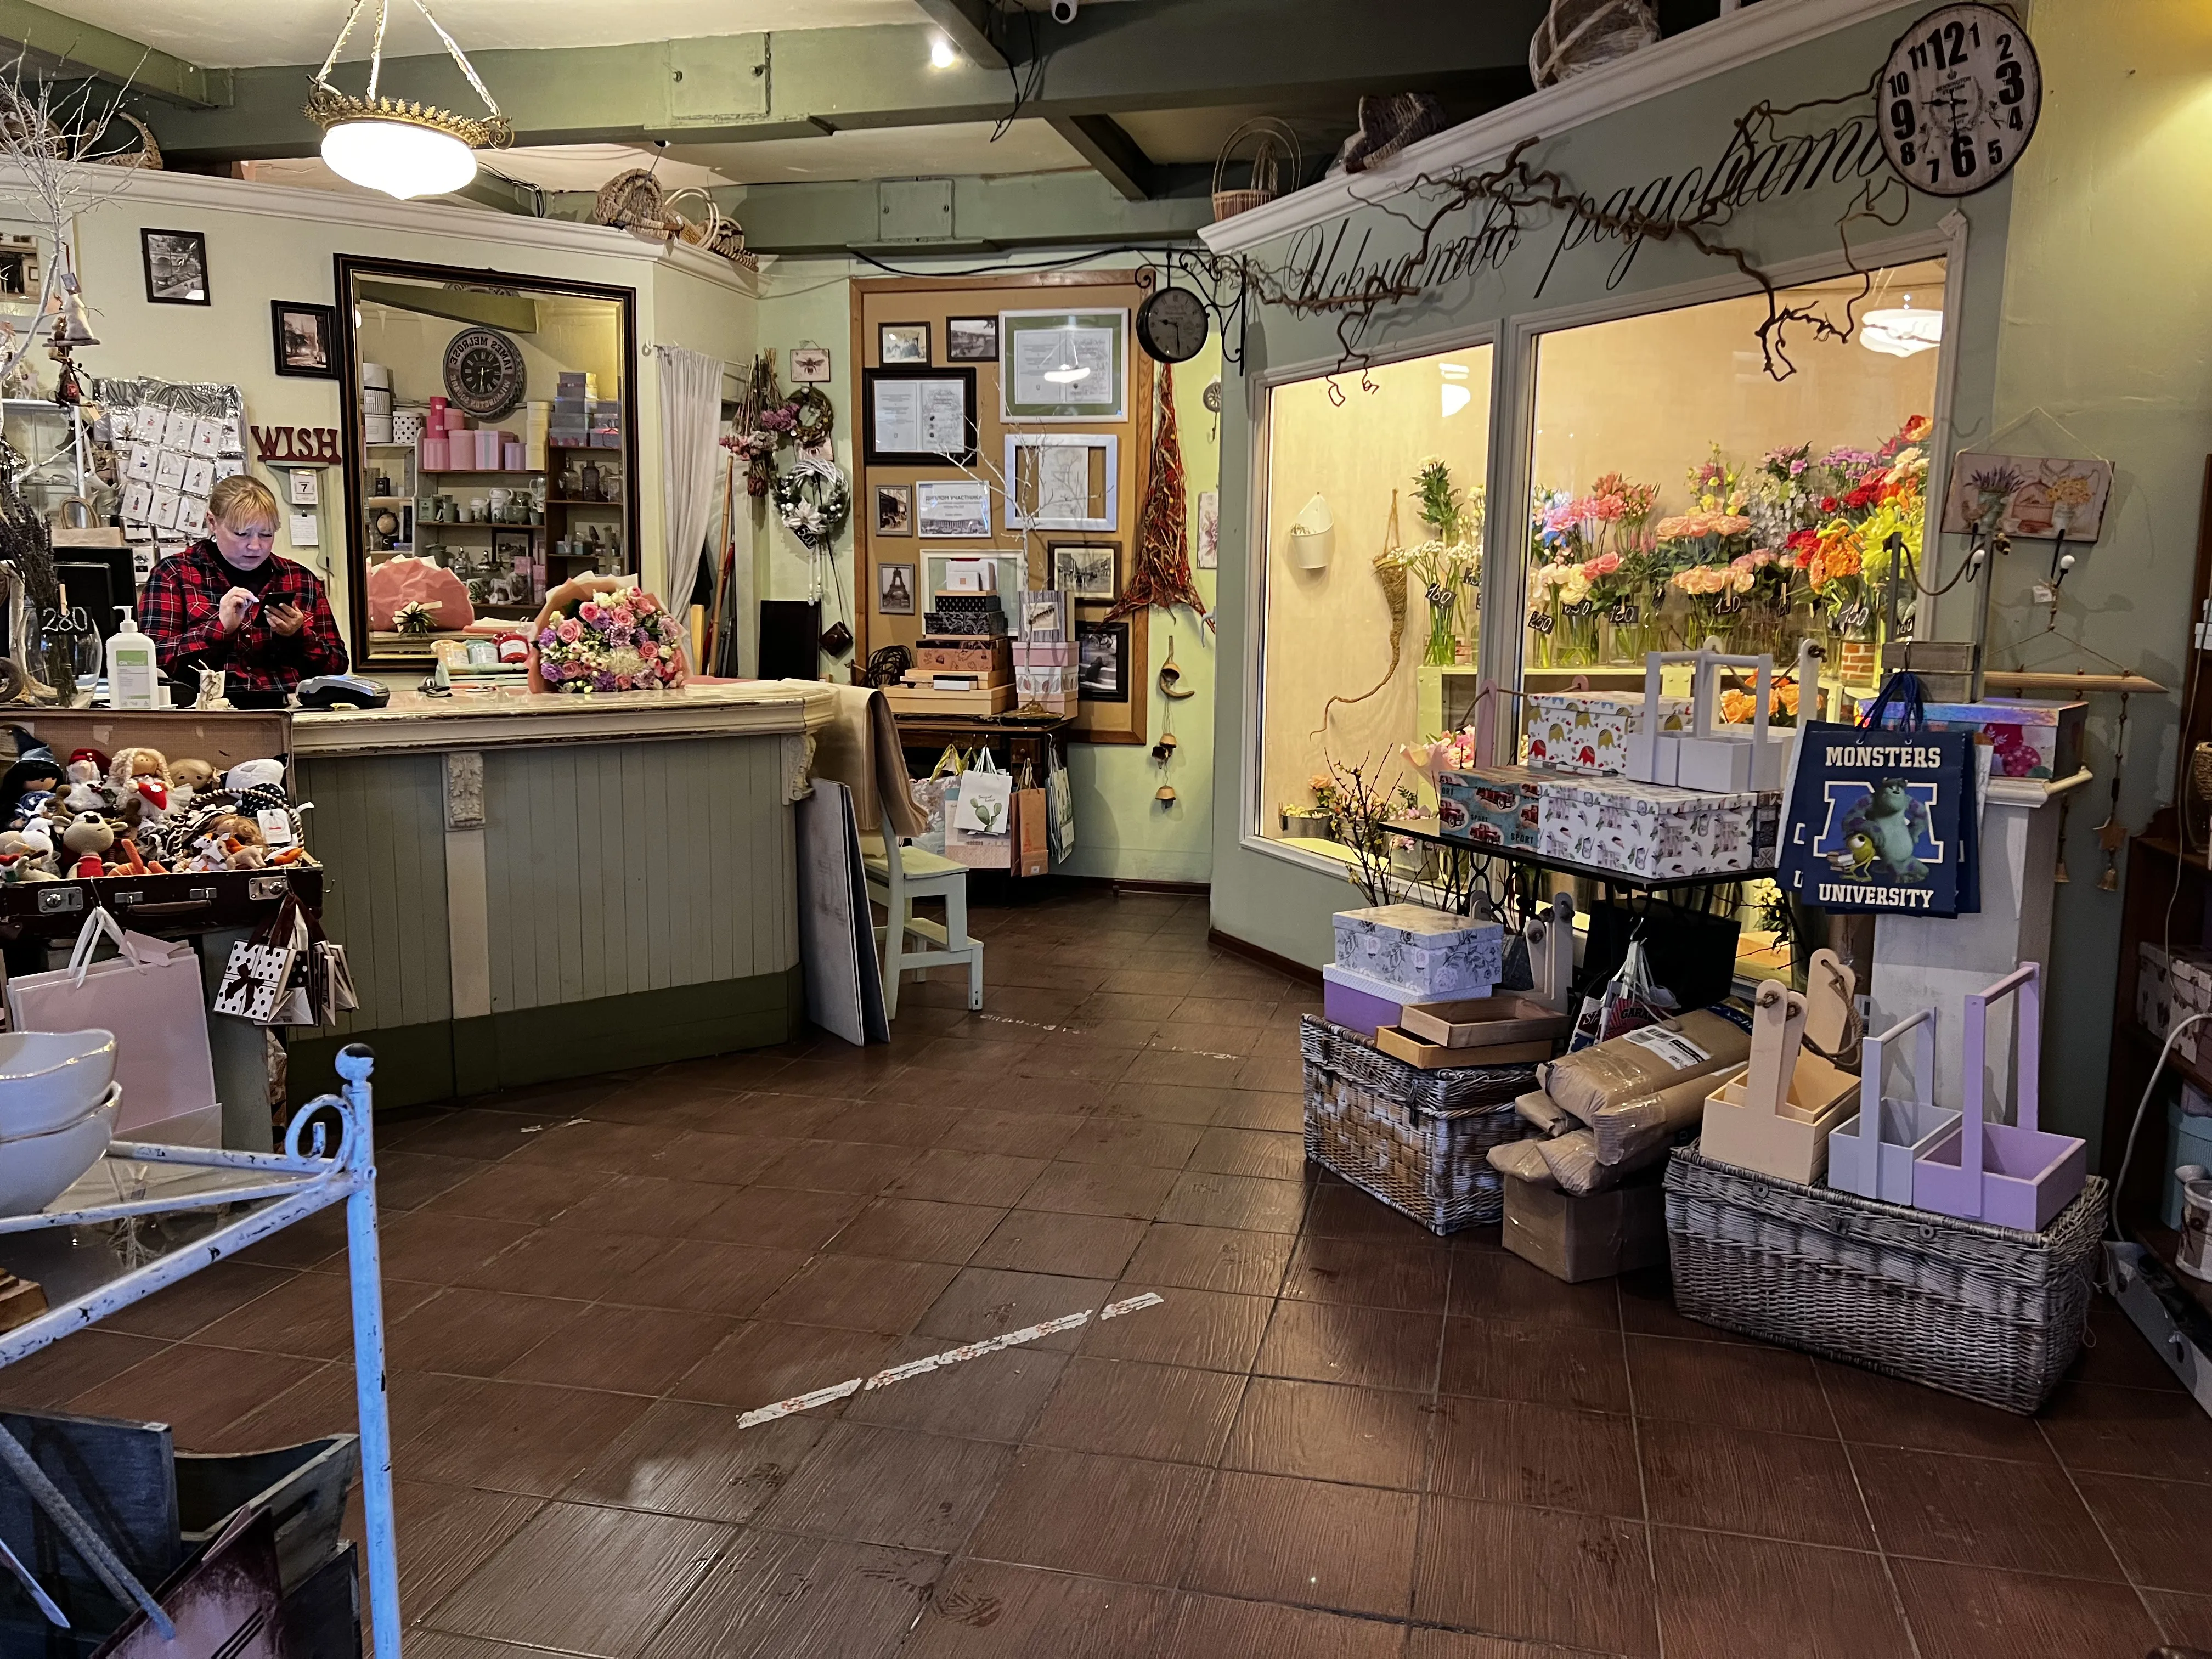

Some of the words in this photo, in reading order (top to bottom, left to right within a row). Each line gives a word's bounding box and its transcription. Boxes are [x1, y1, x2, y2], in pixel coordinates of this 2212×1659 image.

[1927, 21, 1968, 71] 12
[1968, 22, 1981, 48] 1
[1997, 33, 2013, 61] 2
[1908, 42, 1928, 71] 11
[1888, 71, 1910, 98] 10
[1996, 61, 2025, 105] 3
[1891, 99, 1916, 140] 9
[2008, 105, 2024, 131] 4
[1900, 141, 1916, 166] 8
[1951, 135, 1977, 177] 6
[1988, 138, 2003, 165] 5
[1926, 157, 1940, 183] 7
[250, 425, 342, 464] WISH
[301, 483, 308, 492] 7
[42, 606, 88, 631] 280
[1530, 612, 1553, 631] 250
[1825, 746, 1941, 768] MONSTERS
[1470, 814, 1488, 822] SPORT
[1510, 833, 1534, 844] SPORT
[1819, 883, 1934, 909] UNIVERSITY
